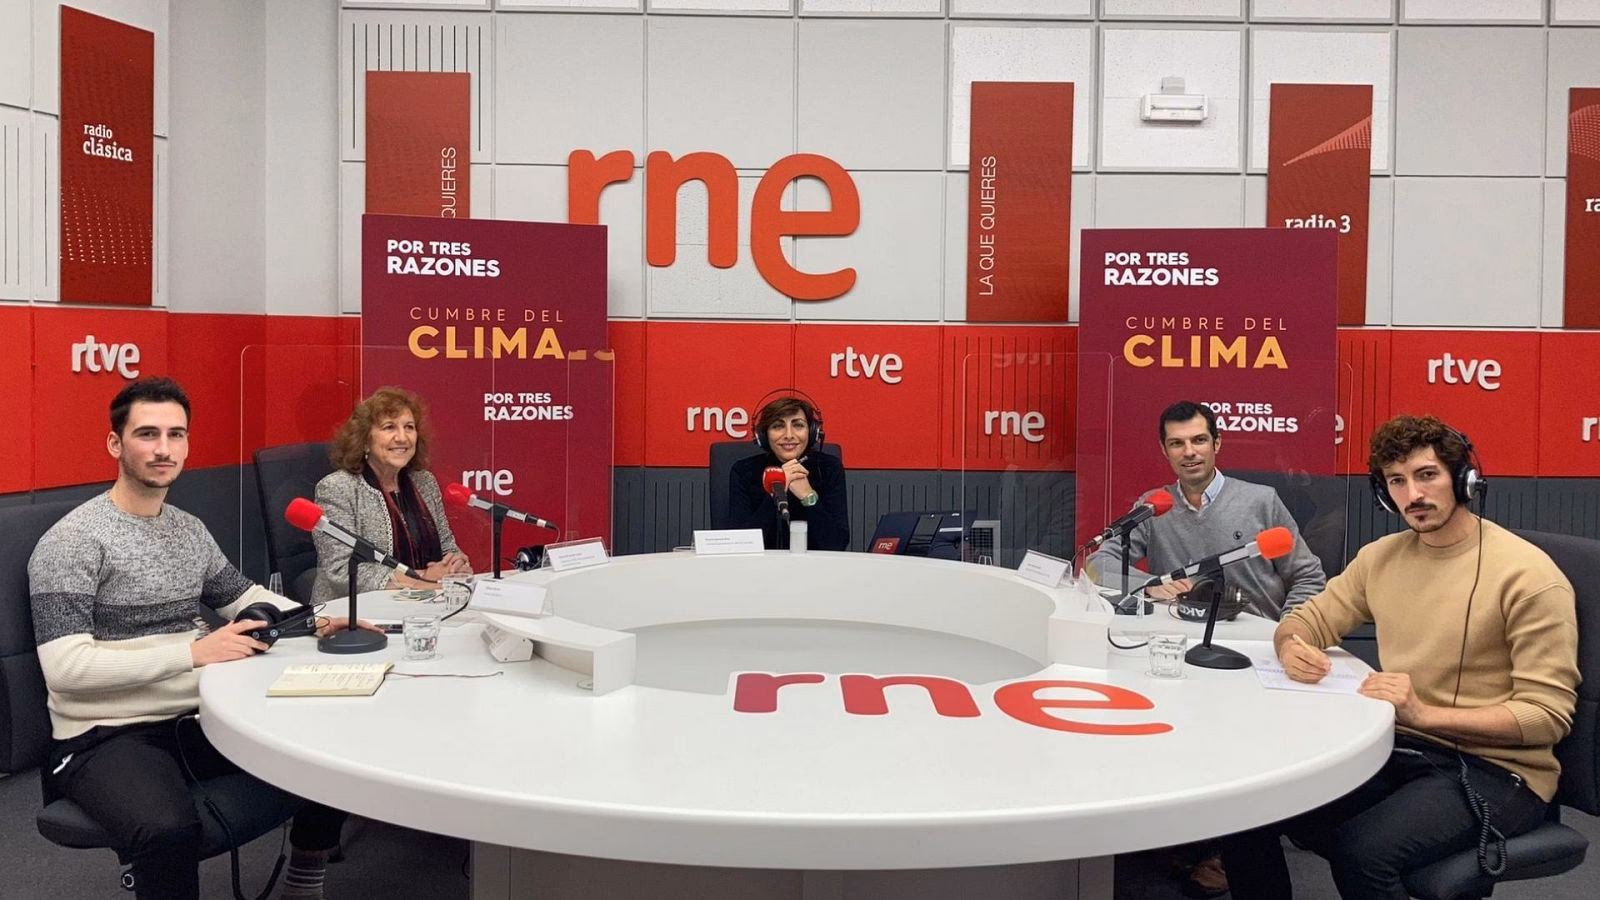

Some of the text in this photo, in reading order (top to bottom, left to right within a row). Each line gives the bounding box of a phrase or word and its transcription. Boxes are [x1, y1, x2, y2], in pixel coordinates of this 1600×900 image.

[83, 124, 113, 139] radio
[83, 137, 133, 161] clásica
[568, 149, 860, 301] rne
[979, 156, 996, 295] LA QUE QUIERES
[1339, 215, 1351, 233] 3
[387, 239, 471, 256] POR TRES
[387, 256, 500, 277] RAZONES
[1105, 252, 1190, 266] POR TRES
[1104, 268, 1220, 286] RAZONES
[410, 306, 563, 323] CUMBRE DEL
[1126, 316, 1287, 331] CUMBRE DEL
[408, 325, 565, 359] CLIMA
[1123, 334, 1289, 369] CLIMA
[71, 335, 140, 379] rtve
[830, 346, 903, 384] rtve
[1428, 352, 1502, 390] rtve
[484, 393, 552, 404] POR TRES
[1236, 402, 1273, 414] TRES
[484, 405, 573, 421] RAZONES
[687, 407, 748, 438] rne
[984, 410, 1045, 442] rne
[1216, 416, 1299, 433] AZONES
[462, 469, 514, 496] rne
[733, 673, 1174, 735] rne
